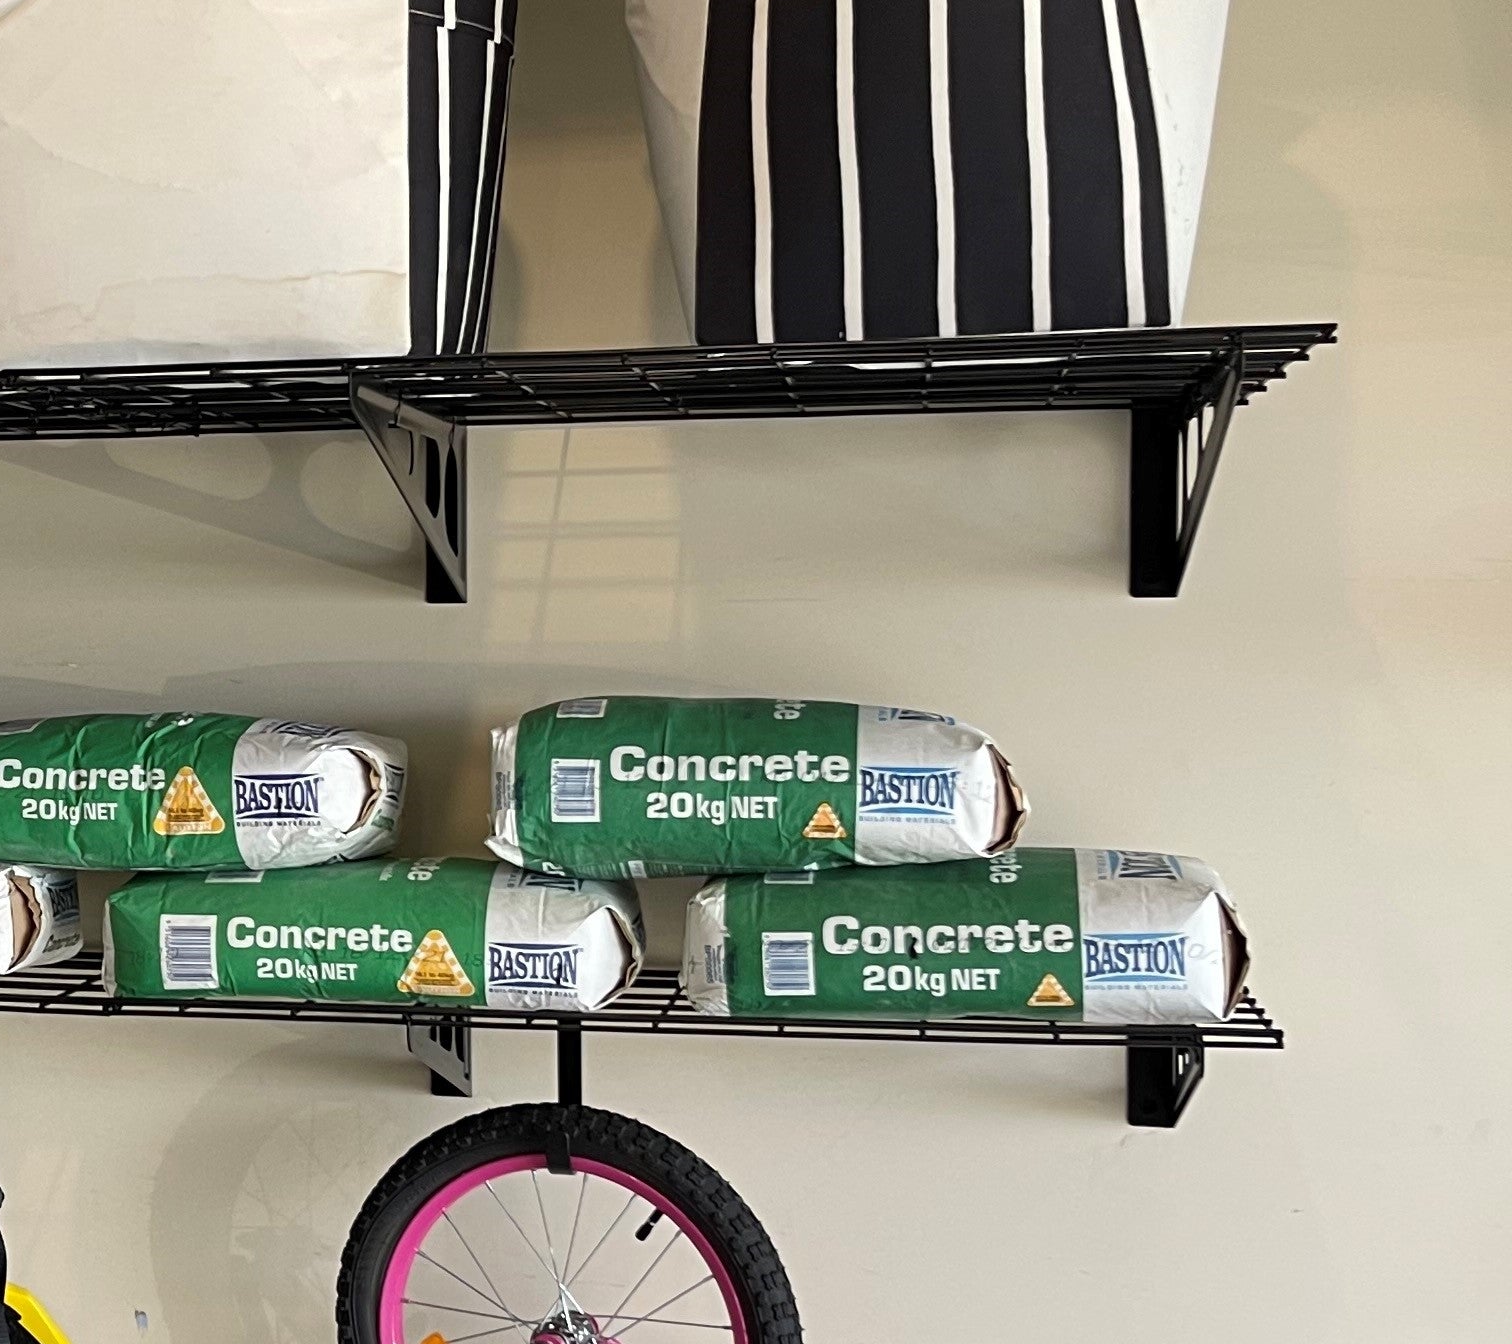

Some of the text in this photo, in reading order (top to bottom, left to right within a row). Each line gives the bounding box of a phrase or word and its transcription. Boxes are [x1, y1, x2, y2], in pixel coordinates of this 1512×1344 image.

[609, 744, 851, 783] Concrete
[234, 777, 320, 815] BASTION
[645, 791, 778, 825] 20kg NET
[859, 768, 957, 810] BASTION
[21, 798, 118, 826] 20kg NET
[226, 915, 414, 953] Concrete
[821, 914, 1075, 955] Concrete
[256, 957, 319, 984] 20kg
[321, 962, 358, 981] NET
[488, 945, 579, 986] BASTION
[1083, 936, 1188, 978] BASTION
[862, 964, 1000, 997] 20kg NET
